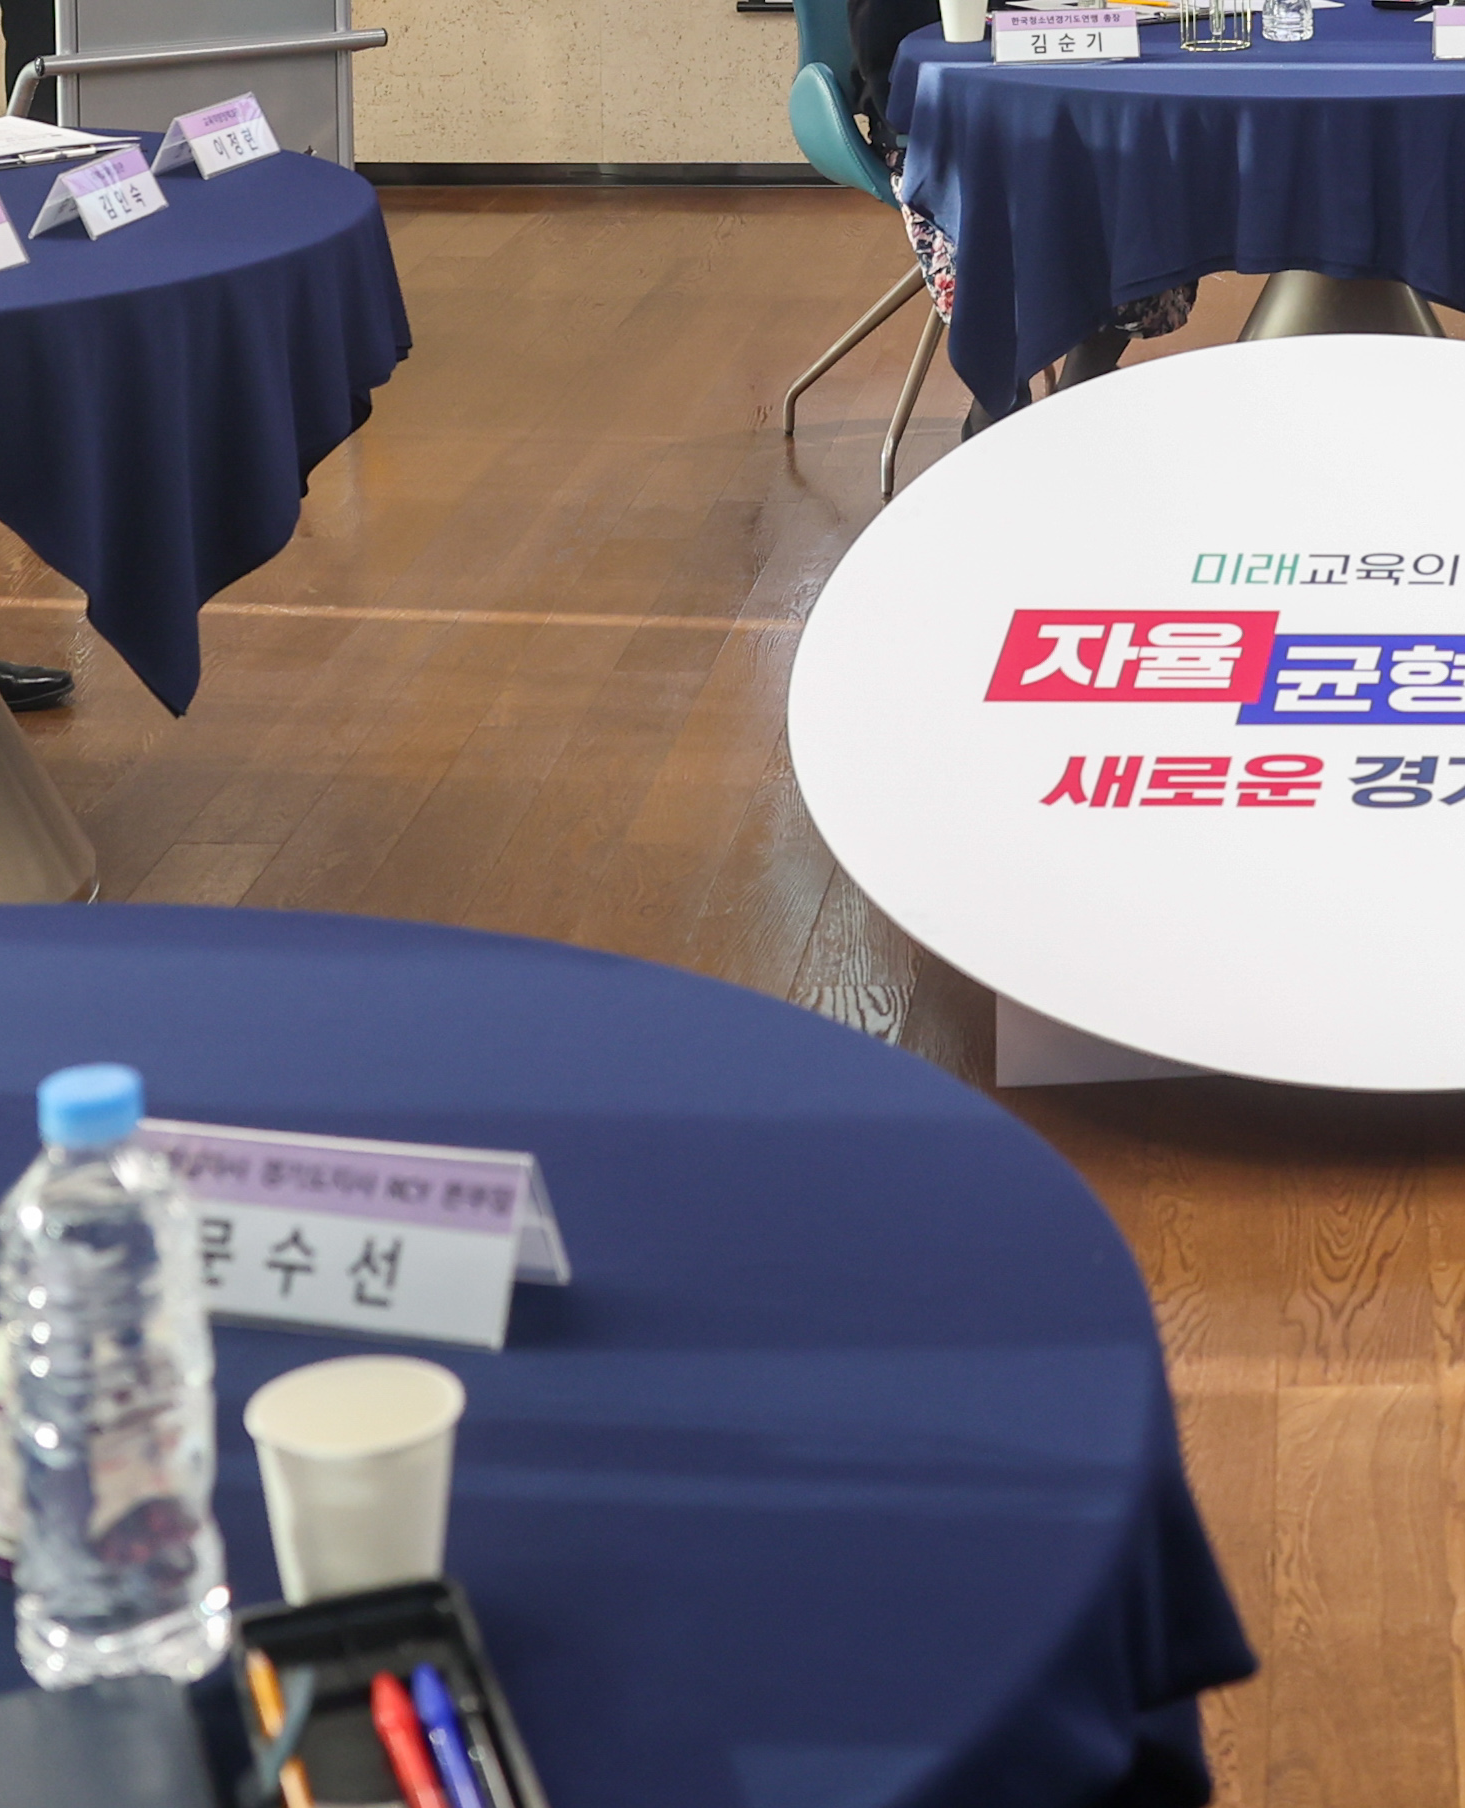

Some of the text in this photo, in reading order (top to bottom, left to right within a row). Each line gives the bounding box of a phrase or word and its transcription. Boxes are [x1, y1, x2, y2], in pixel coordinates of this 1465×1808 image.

[1191, 553, 1460, 586] 미래교육의
[1020, 621, 1243, 691] 자율
[1039, 753, 1325, 809] 새로운
